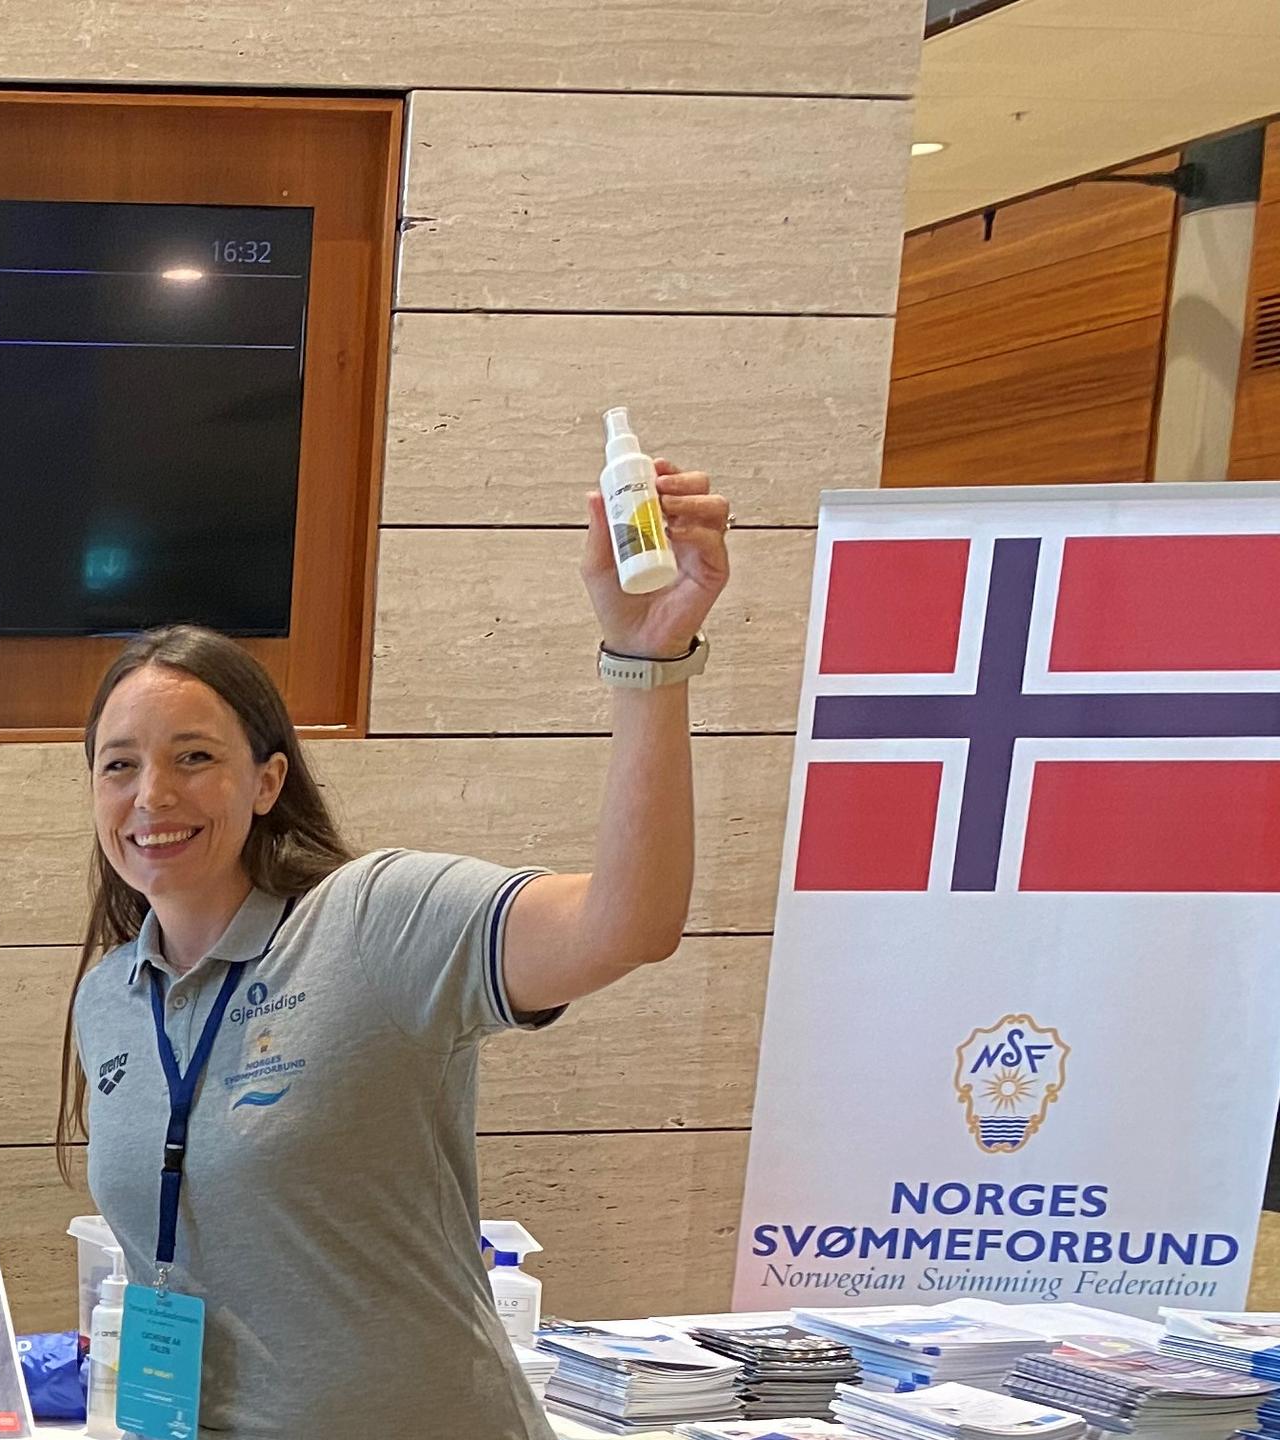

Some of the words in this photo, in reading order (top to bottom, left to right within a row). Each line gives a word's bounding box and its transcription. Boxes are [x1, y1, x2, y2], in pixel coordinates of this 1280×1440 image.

[210, 240, 272, 264] 16:32
[229, 991, 306, 1026] Gjensidige
[99, 1052, 129, 1078] arena
[970, 1029, 1053, 1074] NSF
[889, 1181, 1109, 1218] NORGES
[752, 1224, 1239, 1267] SVØMMEFORBUND
[760, 1263, 905, 1298] Norwegian
[917, 1266, 1062, 1300] Swimming
[1074, 1270, 1218, 1298] Federation
